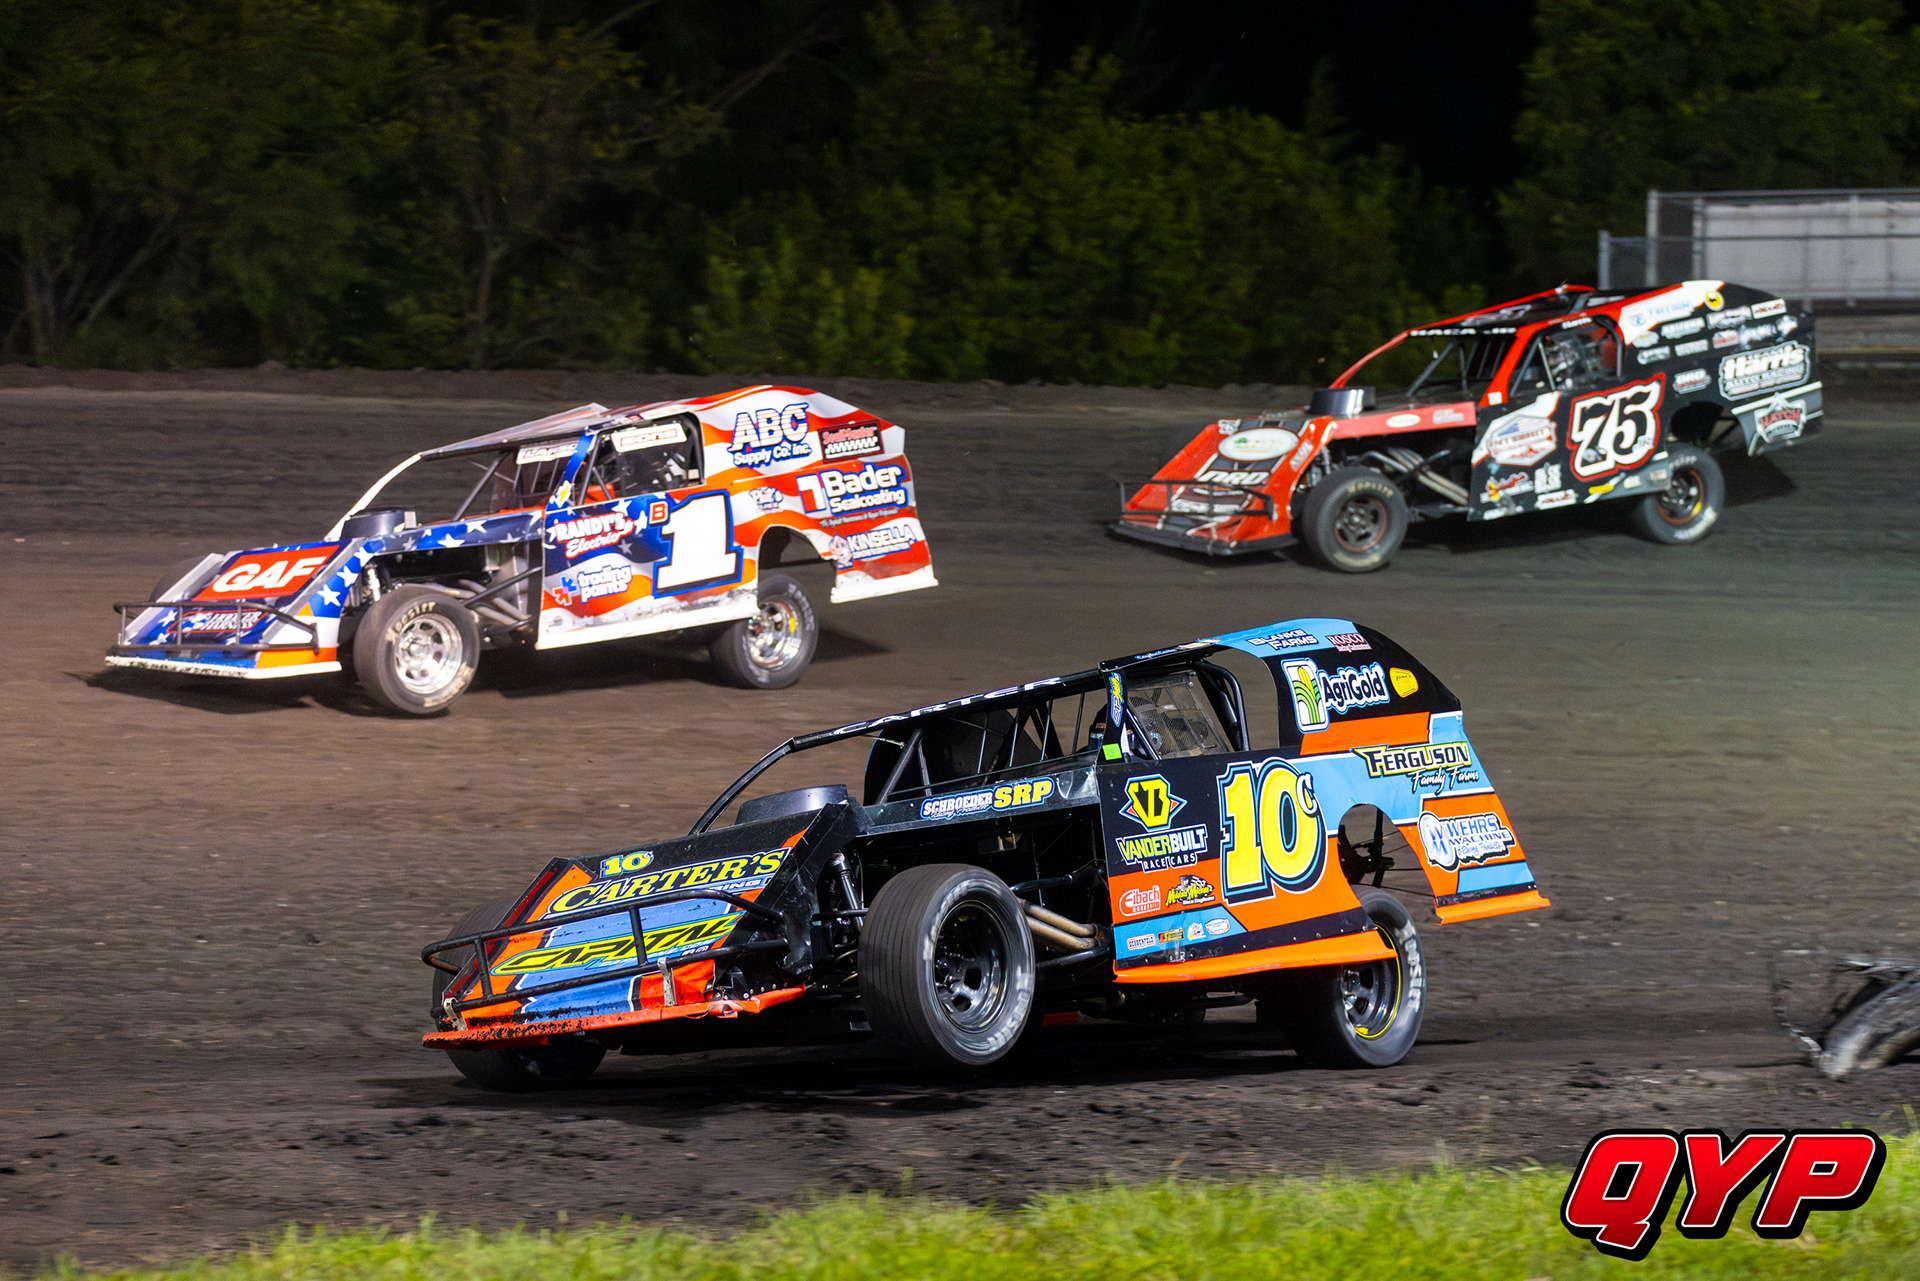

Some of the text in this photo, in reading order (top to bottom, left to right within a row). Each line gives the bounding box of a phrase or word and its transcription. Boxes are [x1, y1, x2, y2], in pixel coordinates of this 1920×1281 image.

[1723, 345, 1805, 380] Harris
[727, 402, 809, 452] ABC
[1571, 379, 1662, 477] 75
[734, 447, 772, 466] Supply
[773, 445, 791, 460] Co.
[820, 464, 903, 498] Bader
[651, 502, 667, 523] B
[829, 488, 906, 513] Sealcoating
[555, 512, 627, 542] RANDY'S
[655, 492, 738, 592] 1
[847, 524, 918, 552] KINSELLA
[565, 529, 621, 558] Electric
[212, 555, 327, 593] GAF
[577, 564, 632, 588] trading
[1247, 628, 1308, 646] BLANKE
[1268, 634, 1319, 651] FARMS
[1326, 631, 1367, 646] ROSCO
[1321, 668, 1387, 709] AgriGold
[1358, 744, 1470, 774] FERGUSON
[1406, 763, 1480, 795] Family Farms
[922, 779, 1053, 816] SCHROEDER SRP
[1445, 816, 1499, 838] WEHRS
[1448, 831, 1511, 846] MACHINE
[1118, 828, 1206, 861] VANDERBUILT
[1143, 852, 1196, 870] RACE CARS
[551, 849, 787, 913] CARTER'S
[1122, 885, 1161, 907] Eibach
[500, 915, 736, 972] CAPITAL
